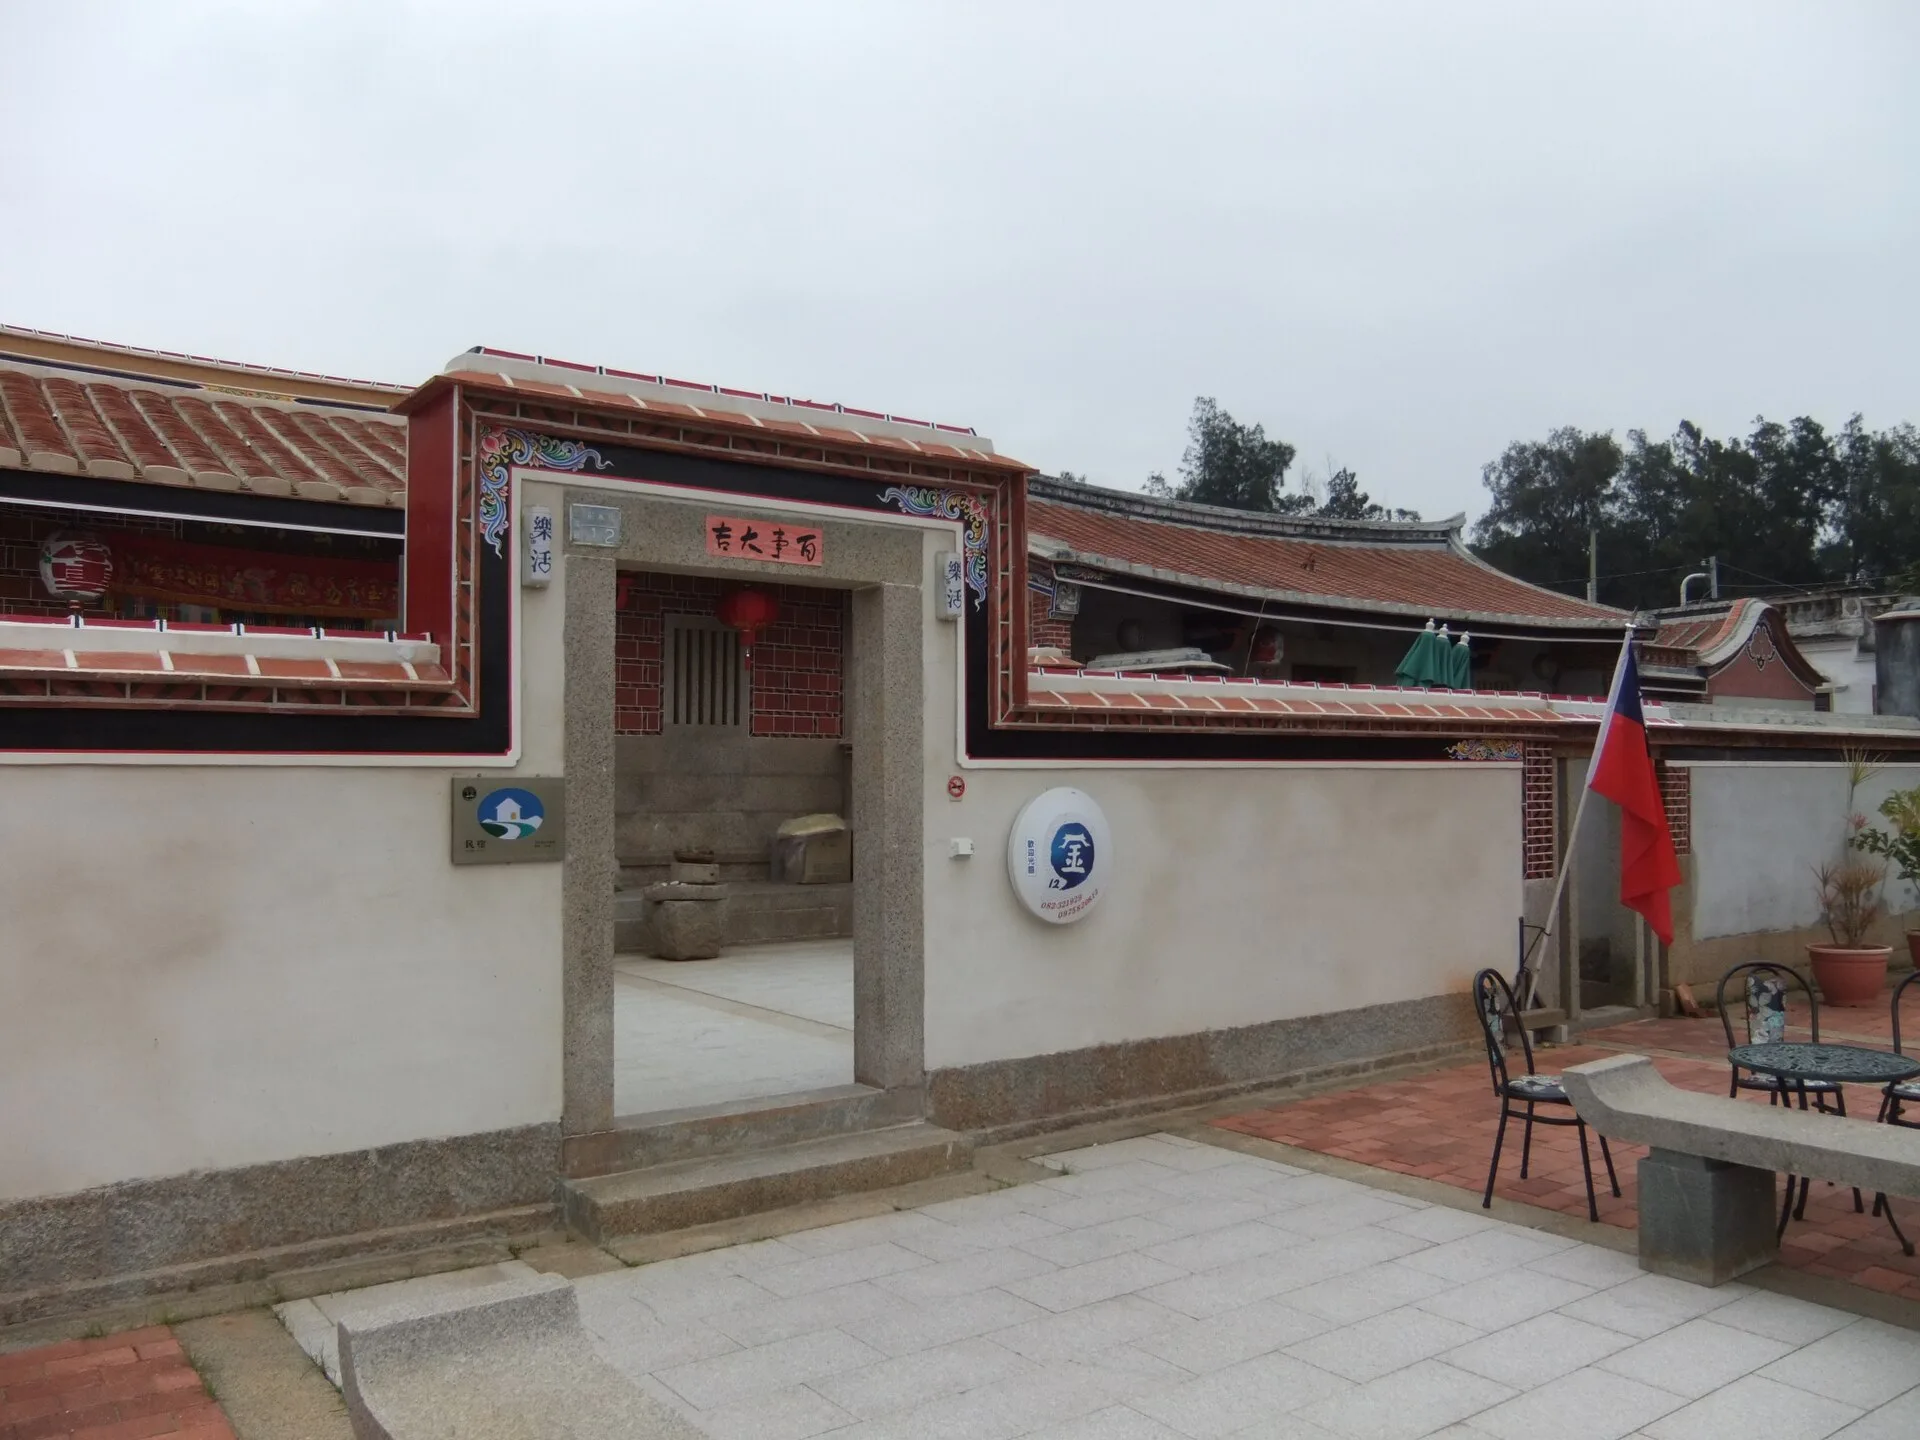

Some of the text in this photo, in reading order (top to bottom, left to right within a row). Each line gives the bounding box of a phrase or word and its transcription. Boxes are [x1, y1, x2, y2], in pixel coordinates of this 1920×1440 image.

[530, 516, 551, 573] 樂活
[946, 560, 961, 609] 樂活
[1048, 878, 1060, 889] 12
